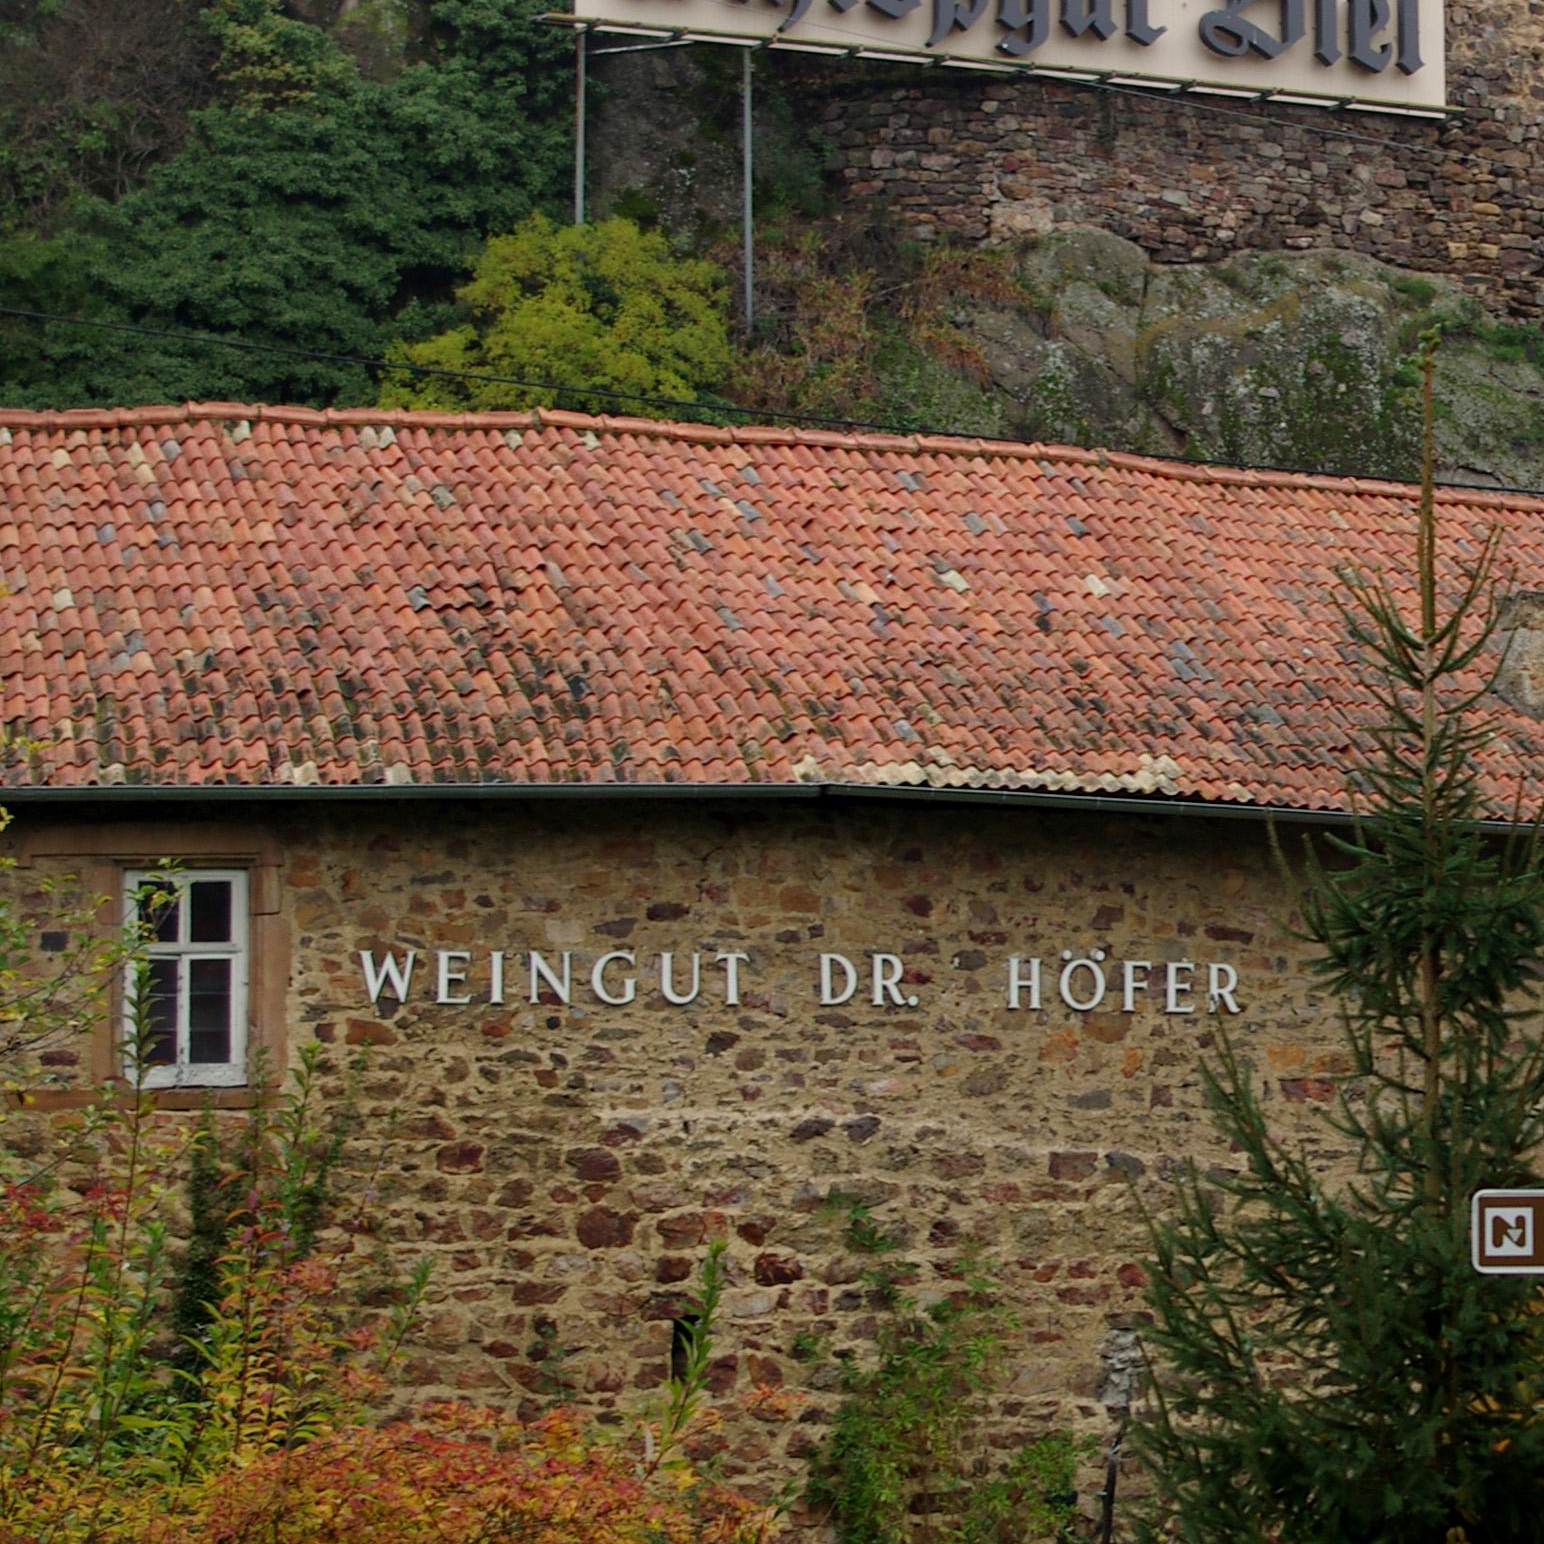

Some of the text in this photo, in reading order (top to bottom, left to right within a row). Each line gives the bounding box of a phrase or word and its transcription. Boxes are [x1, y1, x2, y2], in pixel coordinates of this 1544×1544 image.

[359, 948, 1241, 1014] WEINGUT DR. HÖFER
